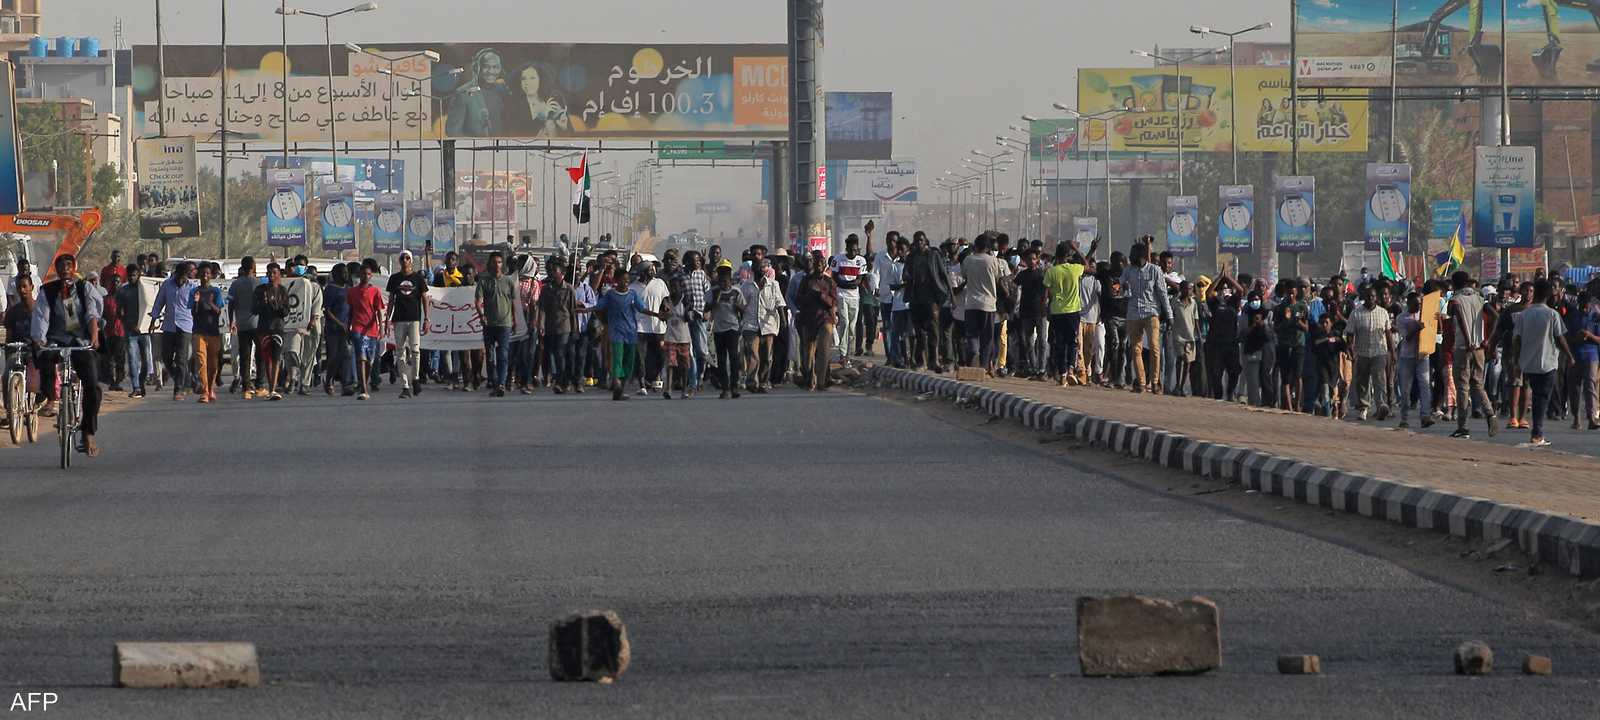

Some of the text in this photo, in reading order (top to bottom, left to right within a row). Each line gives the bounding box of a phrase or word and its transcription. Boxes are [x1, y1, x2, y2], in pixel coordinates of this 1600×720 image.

[608, 56, 712, 86] الخرطوم
[741, 64, 787, 87] MC
[273, 82, 284, 99] 8
[288, 88, 312, 102] من
[352, 105, 400, 122] عاطف
[583, 90, 714, 122] 100.3 إف إم
[181, 112, 209, 127] عبد
[268, 106, 311, 128] صاح
[316, 112, 347, 131] عي
[405, 111, 427, 127] مع
